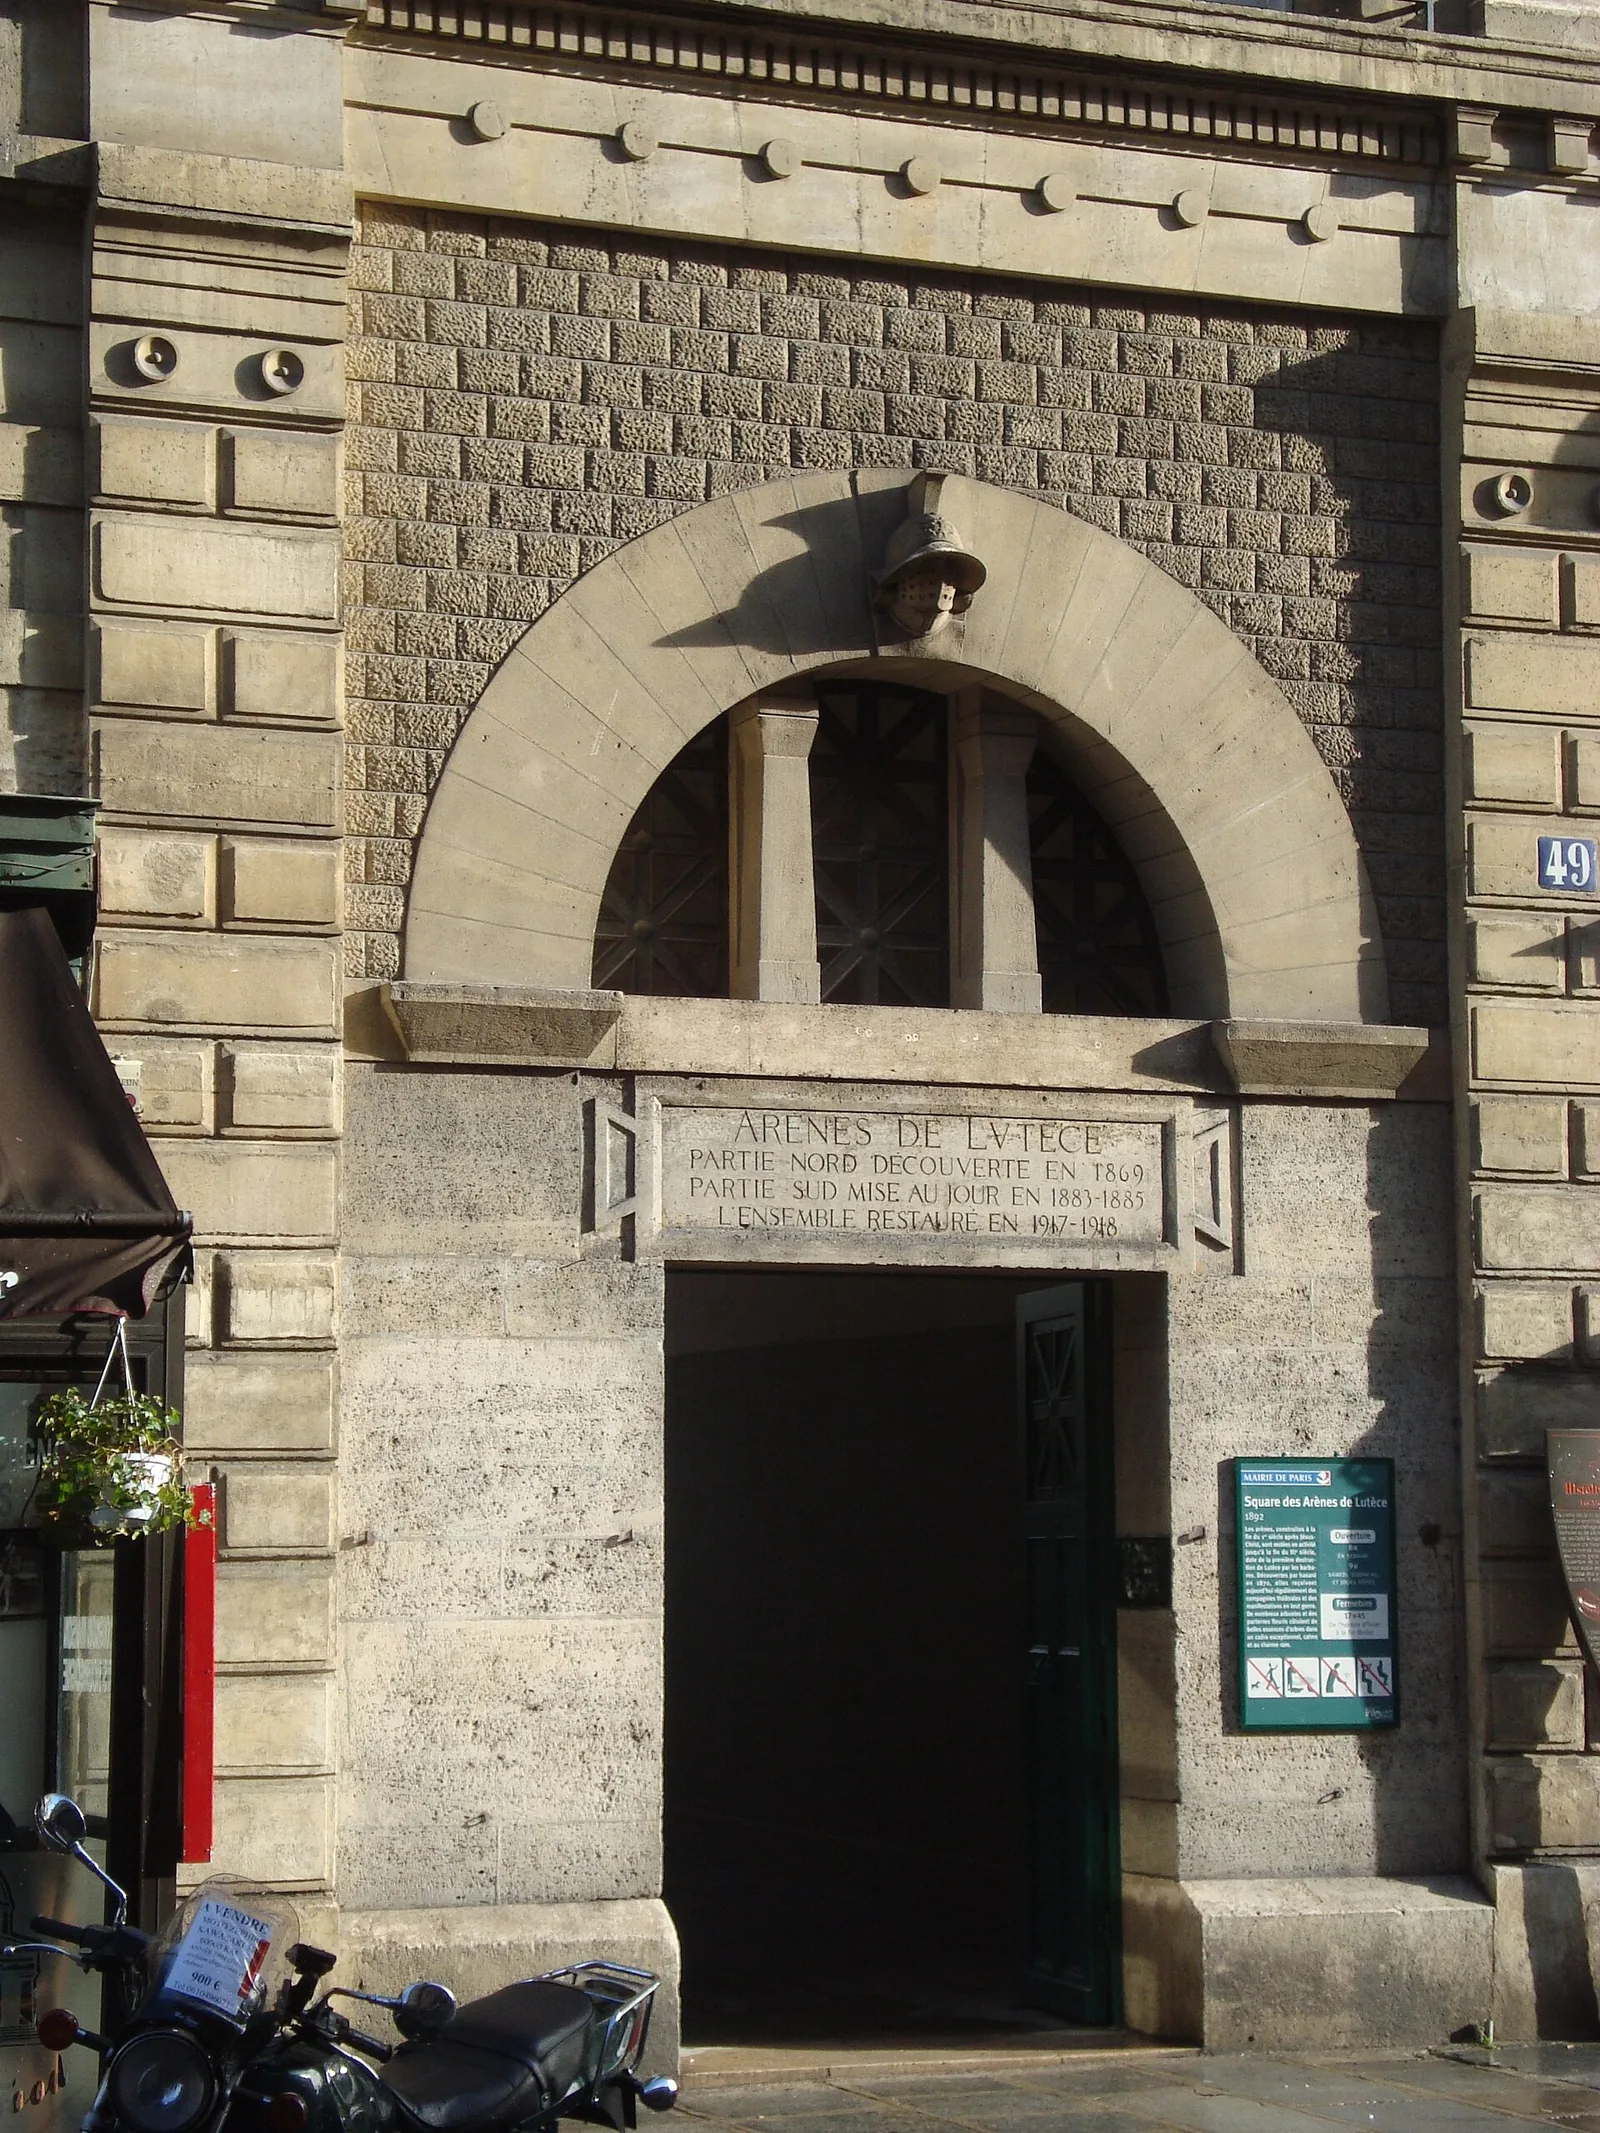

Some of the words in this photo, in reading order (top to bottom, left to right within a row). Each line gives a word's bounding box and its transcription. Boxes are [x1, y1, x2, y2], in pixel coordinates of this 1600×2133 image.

[1545, 840, 1590, 887] 49
[734, 1110, 872, 1146] ARENES
[898, 1117, 941, 1149] DE
[689, 1149, 775, 1172] PARTIE
[790, 1152, 857, 1174] NORD
[1046, 1160, 1076, 1180] EN
[1094, 1162, 1144, 1187] 1869
[689, 1177, 775, 1200] PARTIE
[793, 1180, 837, 1200] SUD
[848, 1182, 900, 1203] MISE
[908, 1183, 938, 1204] AU
[948, 1184, 999, 1209] JOUR
[1012, 1186, 1040, 1206] EN
[1052, 1188, 1144, 1211] 1883-1885
[719, 1206, 856, 1229] L'ENSEMBLE
[989, 1213, 1018, 1234] EN
[1243, 1473, 1273, 1482] MAIRIE
[1275, 1474, 1287, 1482] DE
[1289, 1474, 1313, 1482] PARIS
[1244, 1495, 1281, 1509] Square
[1283, 1495, 1301, 1508] des
[1303, 1495, 1338, 1508] Arènes
[1340, 1495, 1353, 1508] de
[1355, 1496, 1388, 1508] Lutèce
[1245, 1511, 1265, 1522] 1892
[1335, 1531, 1372, 1540] Ouverture
[1336, 1599, 1374, 1608] Fermeture
[215, 1903, 270, 1935] VENDRE
[192, 1972, 212, 1986] 900
[214, 1980, 222, 1991] €
